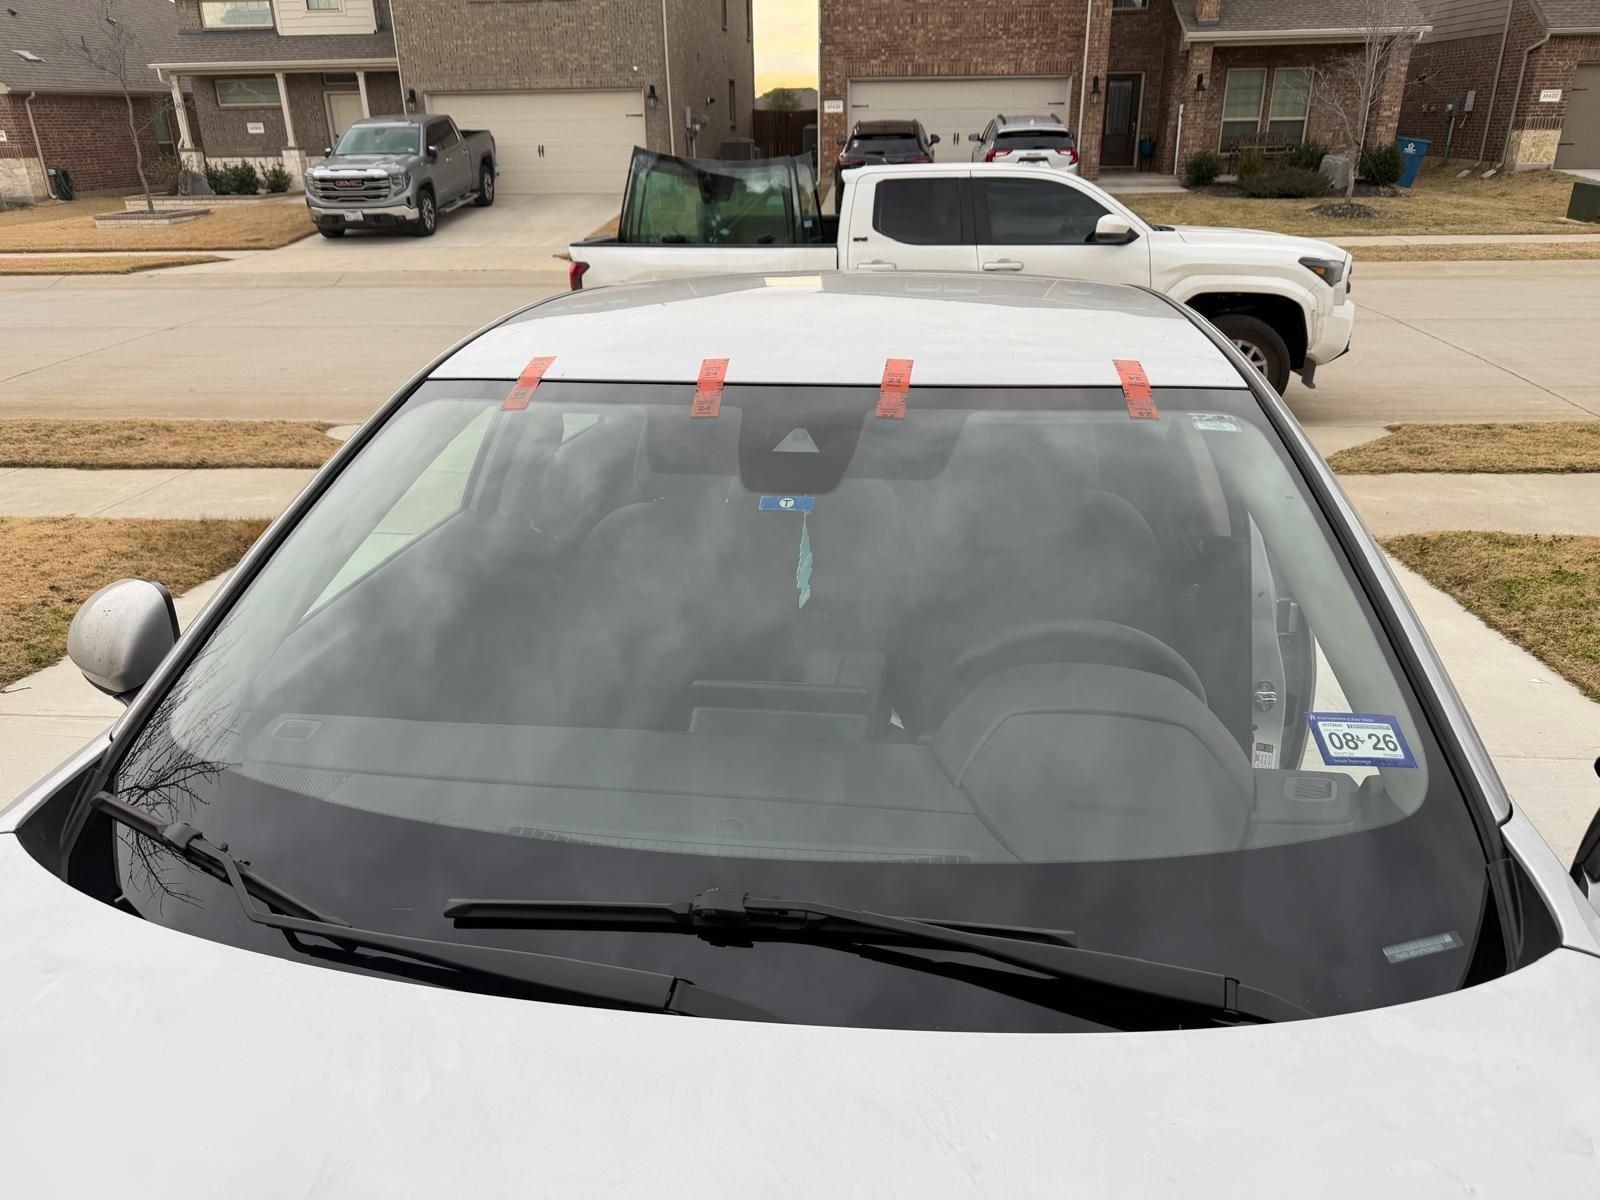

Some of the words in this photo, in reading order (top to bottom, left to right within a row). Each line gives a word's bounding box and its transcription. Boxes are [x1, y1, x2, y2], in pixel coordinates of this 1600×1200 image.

[335, 179, 362, 187] GMC
[783, 499, 793, 507] T
[1328, 732, 1359, 750] 08
[1367, 733, 1398, 751] 26
